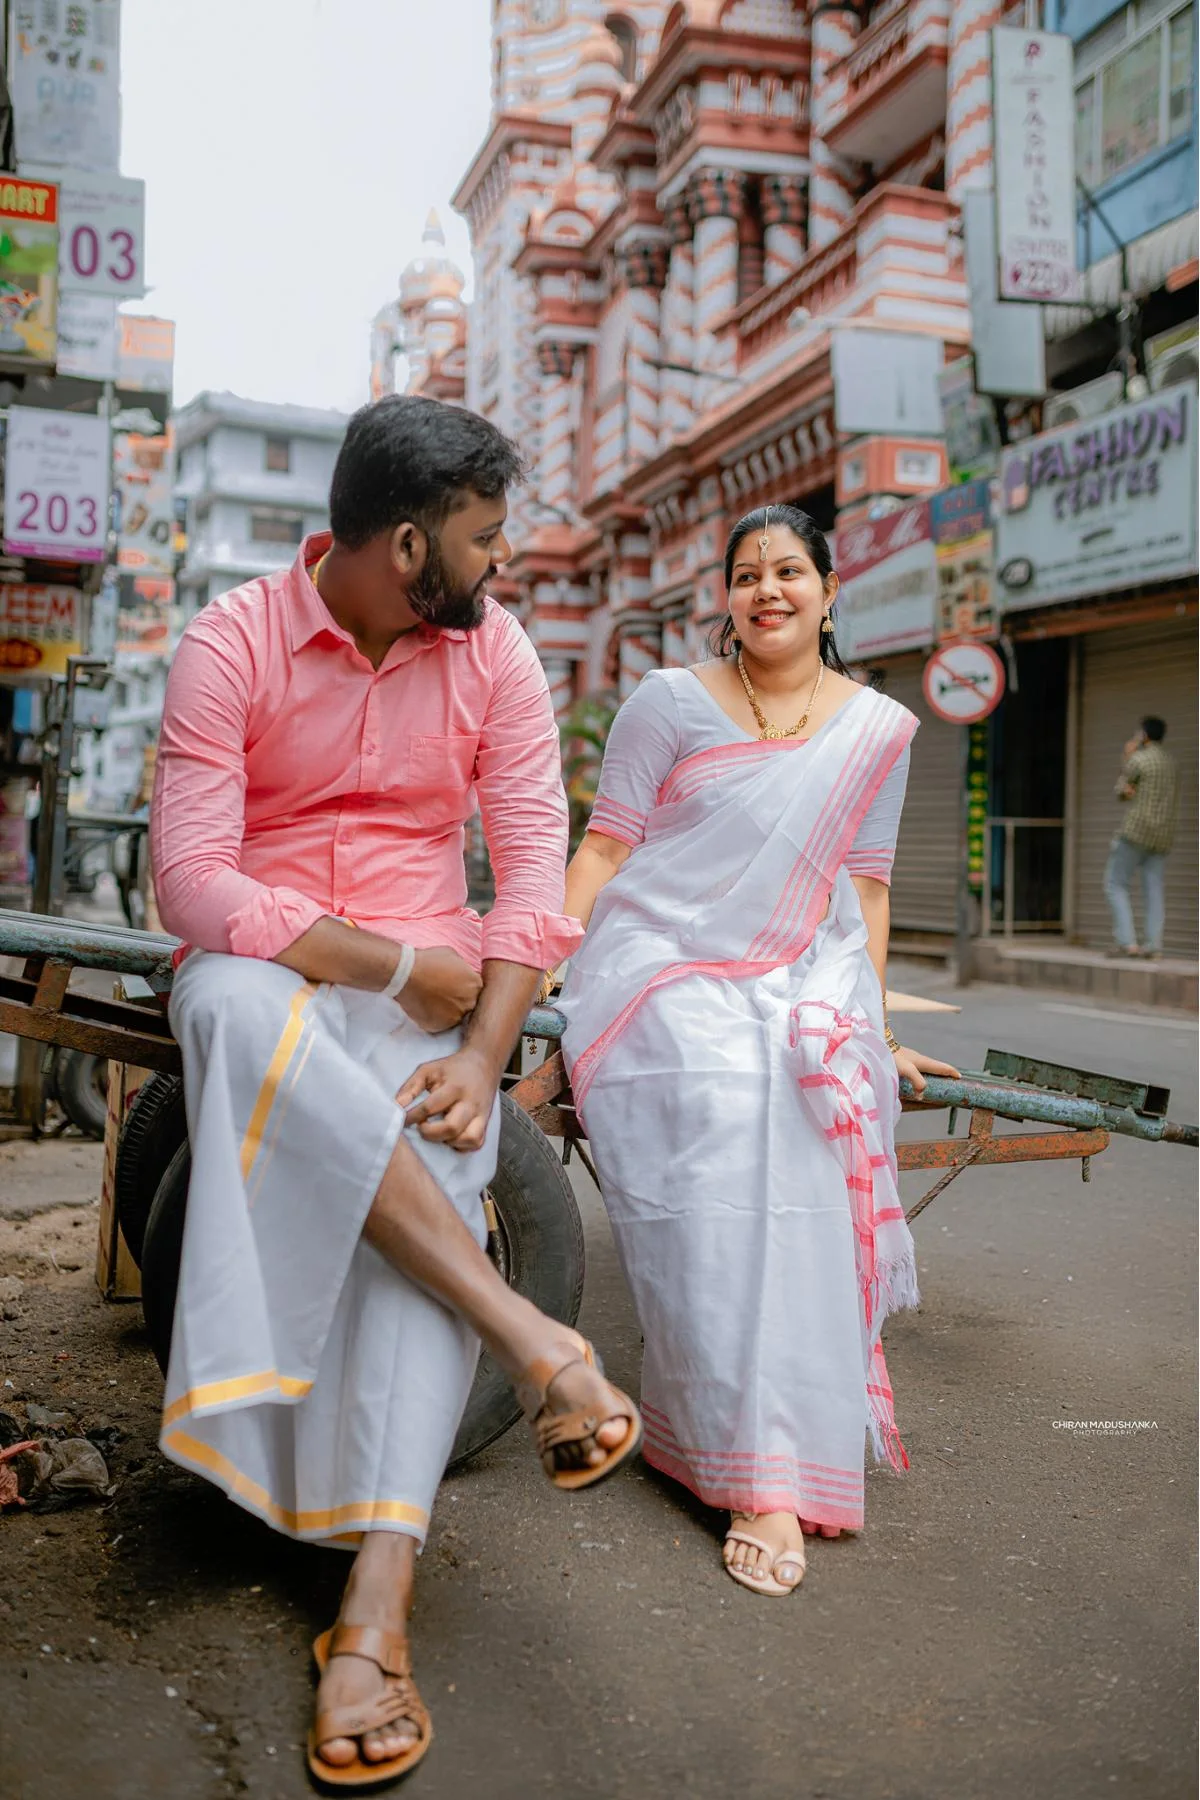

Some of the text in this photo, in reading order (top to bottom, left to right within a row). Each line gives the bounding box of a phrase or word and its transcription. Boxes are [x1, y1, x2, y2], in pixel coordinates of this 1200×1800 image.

[0, 183, 50, 216] ART
[60, 224, 137, 283] 03
[1031, 394, 1187, 487] FASHION
[17, 491, 97, 536] 203
[0, 583, 77, 627] EEM
